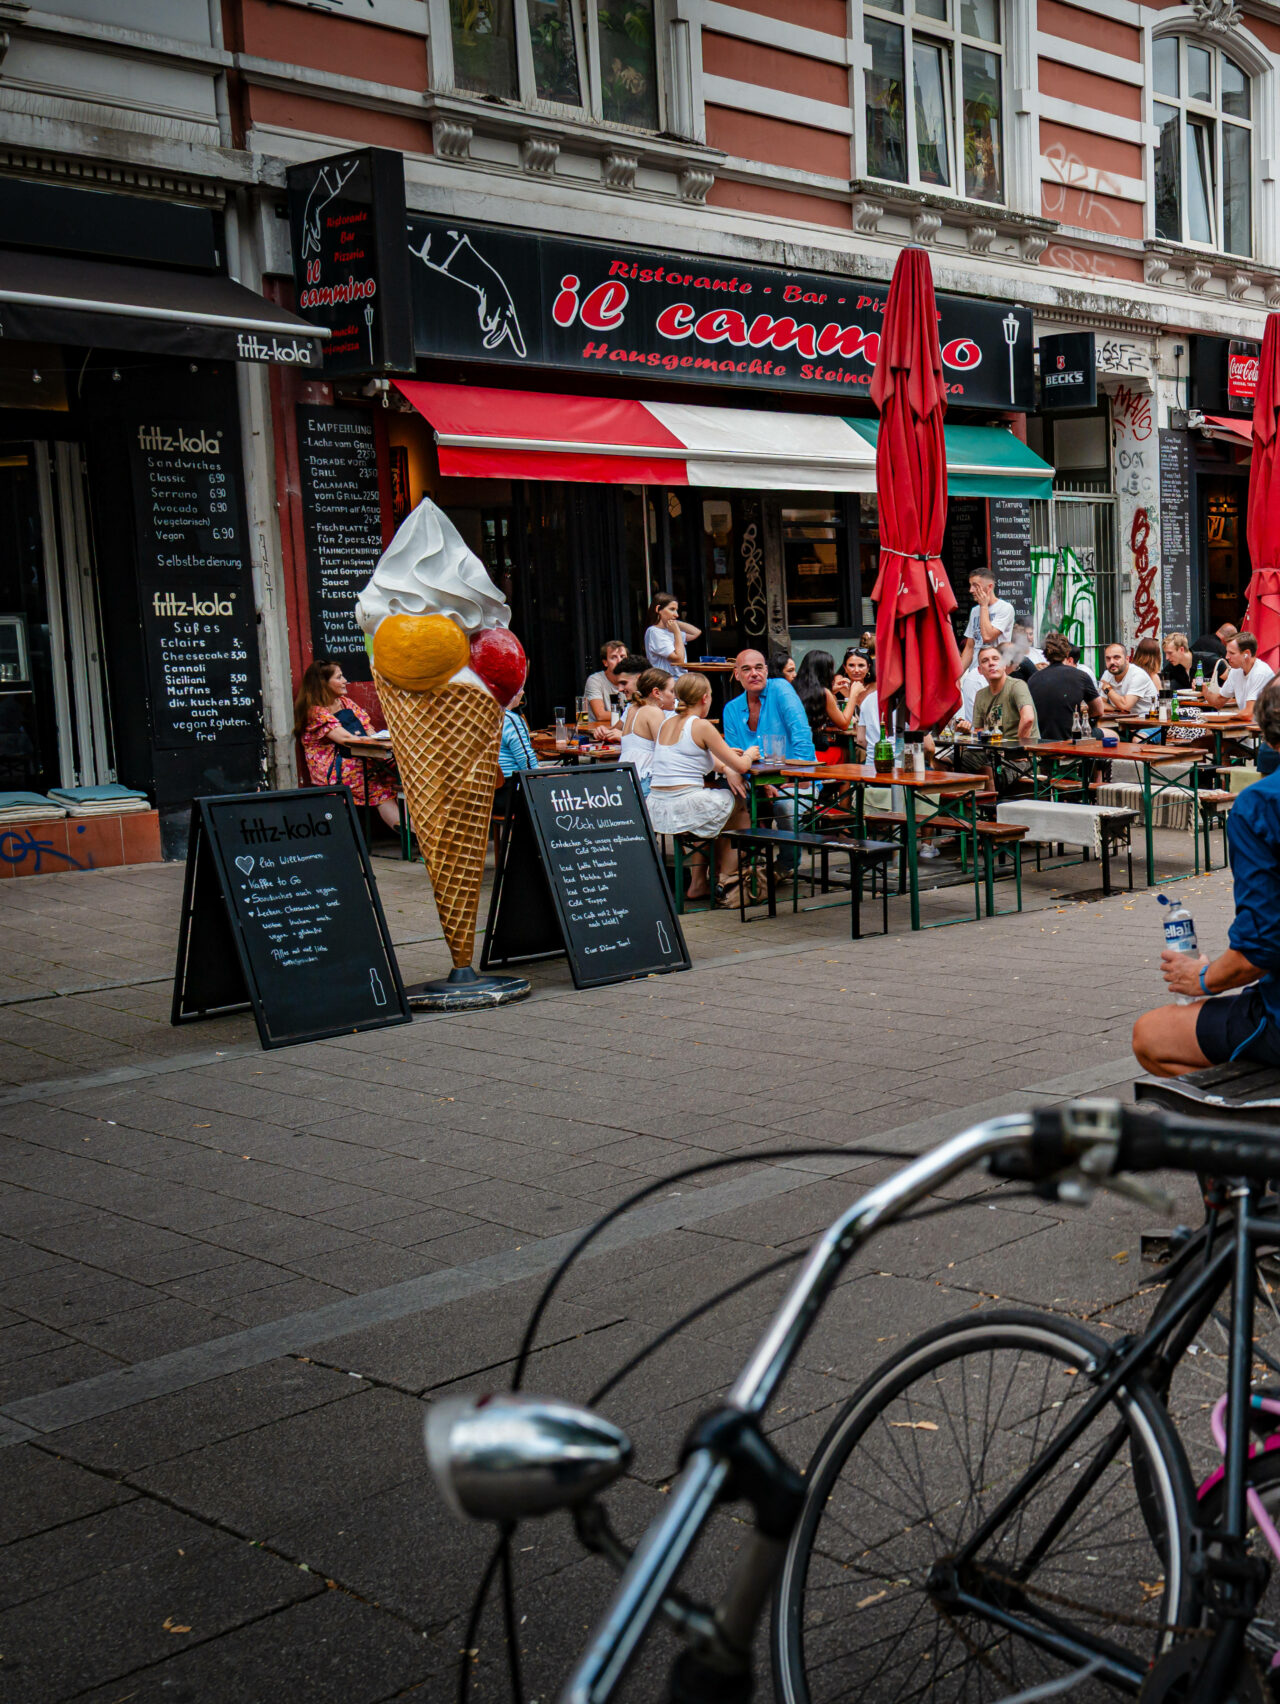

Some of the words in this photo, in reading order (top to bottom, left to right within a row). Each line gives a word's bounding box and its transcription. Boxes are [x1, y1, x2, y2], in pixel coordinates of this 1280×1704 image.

[327, 211, 367, 228] Ristorante
[341, 231, 354, 244] Bar
[334, 249, 364, 262] Pizzeria
[307, 259, 321, 284] il
[609, 260, 752, 294] Ristorante
[783, 285, 827, 304] Bar
[300, 276, 376, 308] cammino
[552, 274, 629, 331] il
[656, 303, 982, 371] cammo
[237, 334, 310, 364] fritz-kola
[583, 341, 786, 377] Hausgemachte
[1045, 371, 1083, 386] BECK'S
[308, 419, 372, 435] EMPFEHLUNG
[138, 425, 219, 454] fritz-kola
[148, 457, 221, 470] Sandwiches
[150, 473, 186, 483] Classic
[151, 487, 197, 499] Serrano
[153, 502, 197, 513] Avocado
[154, 516, 210, 527] (vegetarisch)
[156, 530, 184, 542] Vegan
[157, 555, 242, 569] Selbstbedienung
[340, 568, 374, 577] Gorgonz
[322, 589, 359, 599] FLEISCH
[153, 592, 233, 616] fritz-kola
[174, 622, 220, 635] Süßes
[160, 638, 205, 648] Eclairs
[163, 651, 228, 661] Cheesecake
[164, 664, 205, 673] Cannoli
[166, 675, 205, 684] Siciliani
[167, 686, 210, 695] Muffins
[169, 698, 187, 708] div.
[191, 709, 218, 717] auch
[173, 722, 207, 732] vegan
[196, 732, 216, 741] frei
[551, 786, 622, 812] fritz-kola
[240, 813, 331, 845] fritz-kola
[598, 819, 635, 829] Willkommen
[280, 853, 324, 865] Willkommen
[278, 877, 287, 886] to
[290, 875, 302, 885] Go
[296, 889, 312, 897] auch
[1165, 922, 1184, 938] ella
